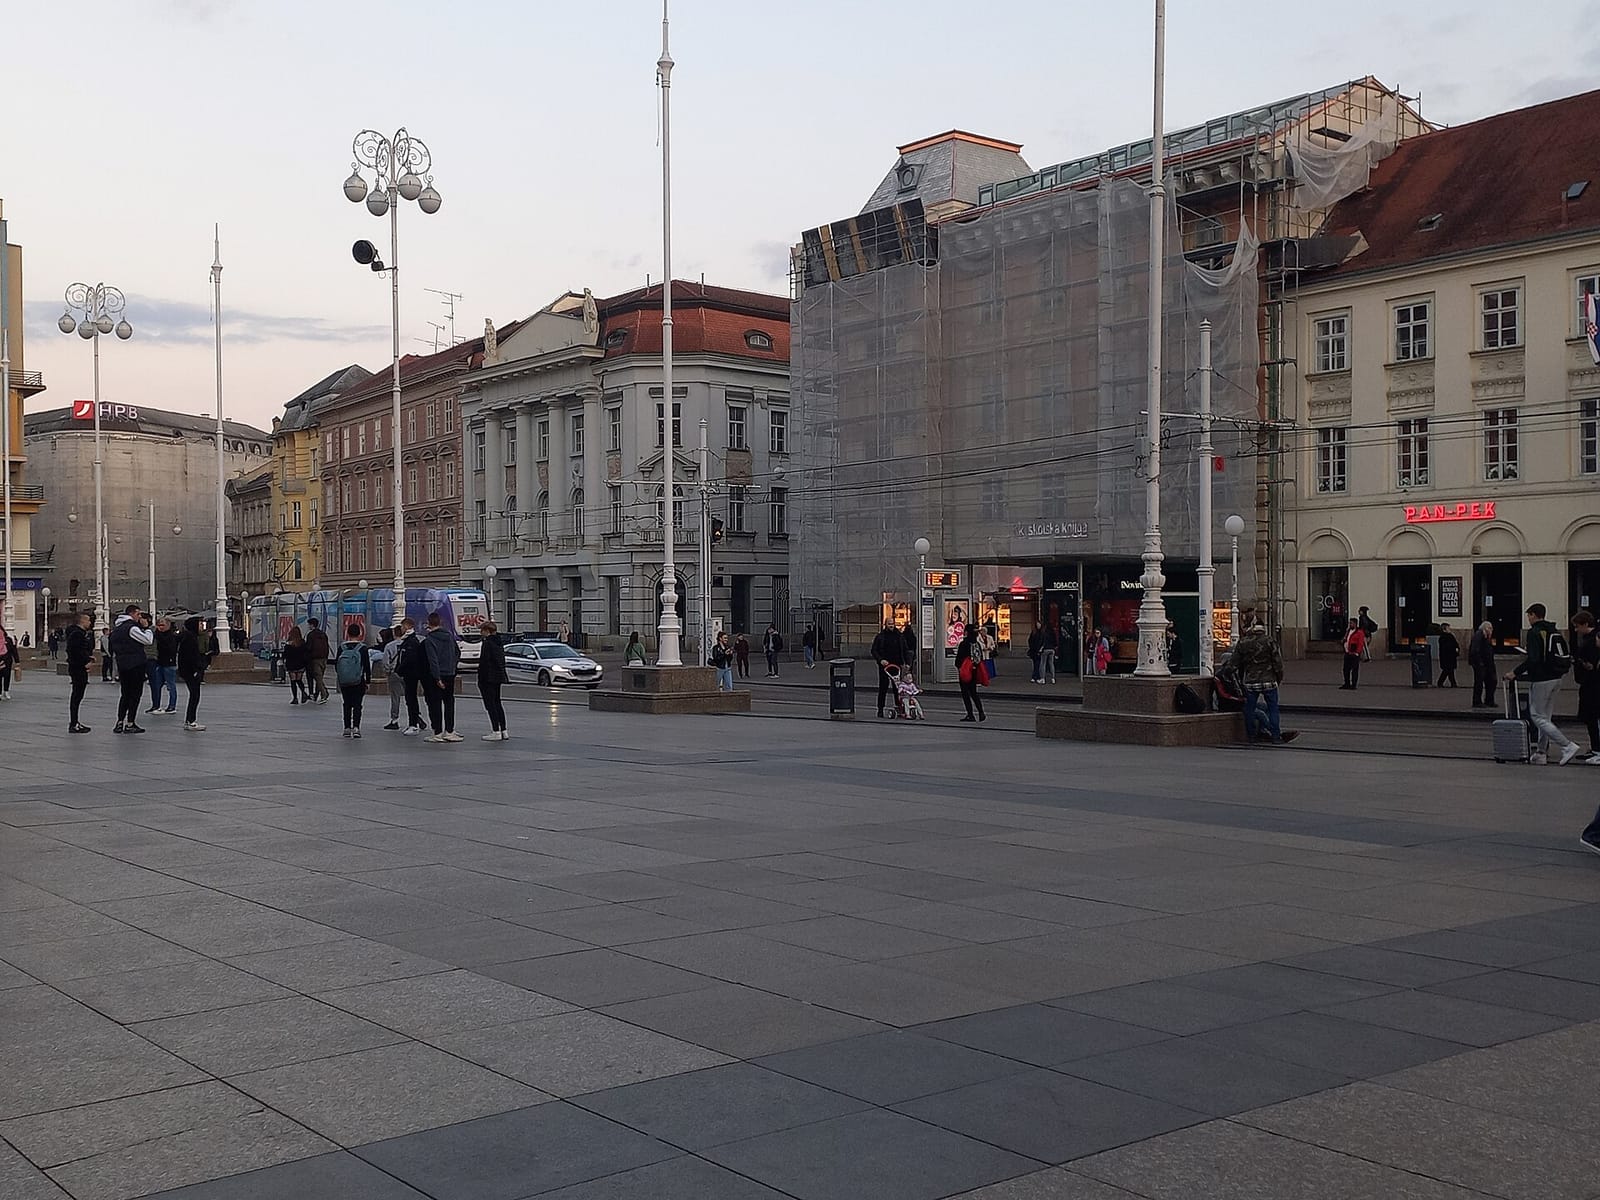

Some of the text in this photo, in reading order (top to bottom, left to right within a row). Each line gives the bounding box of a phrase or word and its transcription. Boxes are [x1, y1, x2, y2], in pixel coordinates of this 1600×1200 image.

[99, 403, 138, 420] HPB
[1405, 502, 1495, 521] PAN-PEK
[1053, 581, 1079, 589] TOBACC
[1442, 592, 1459, 601] PIZZA
[457, 614, 486, 627] FAKS
